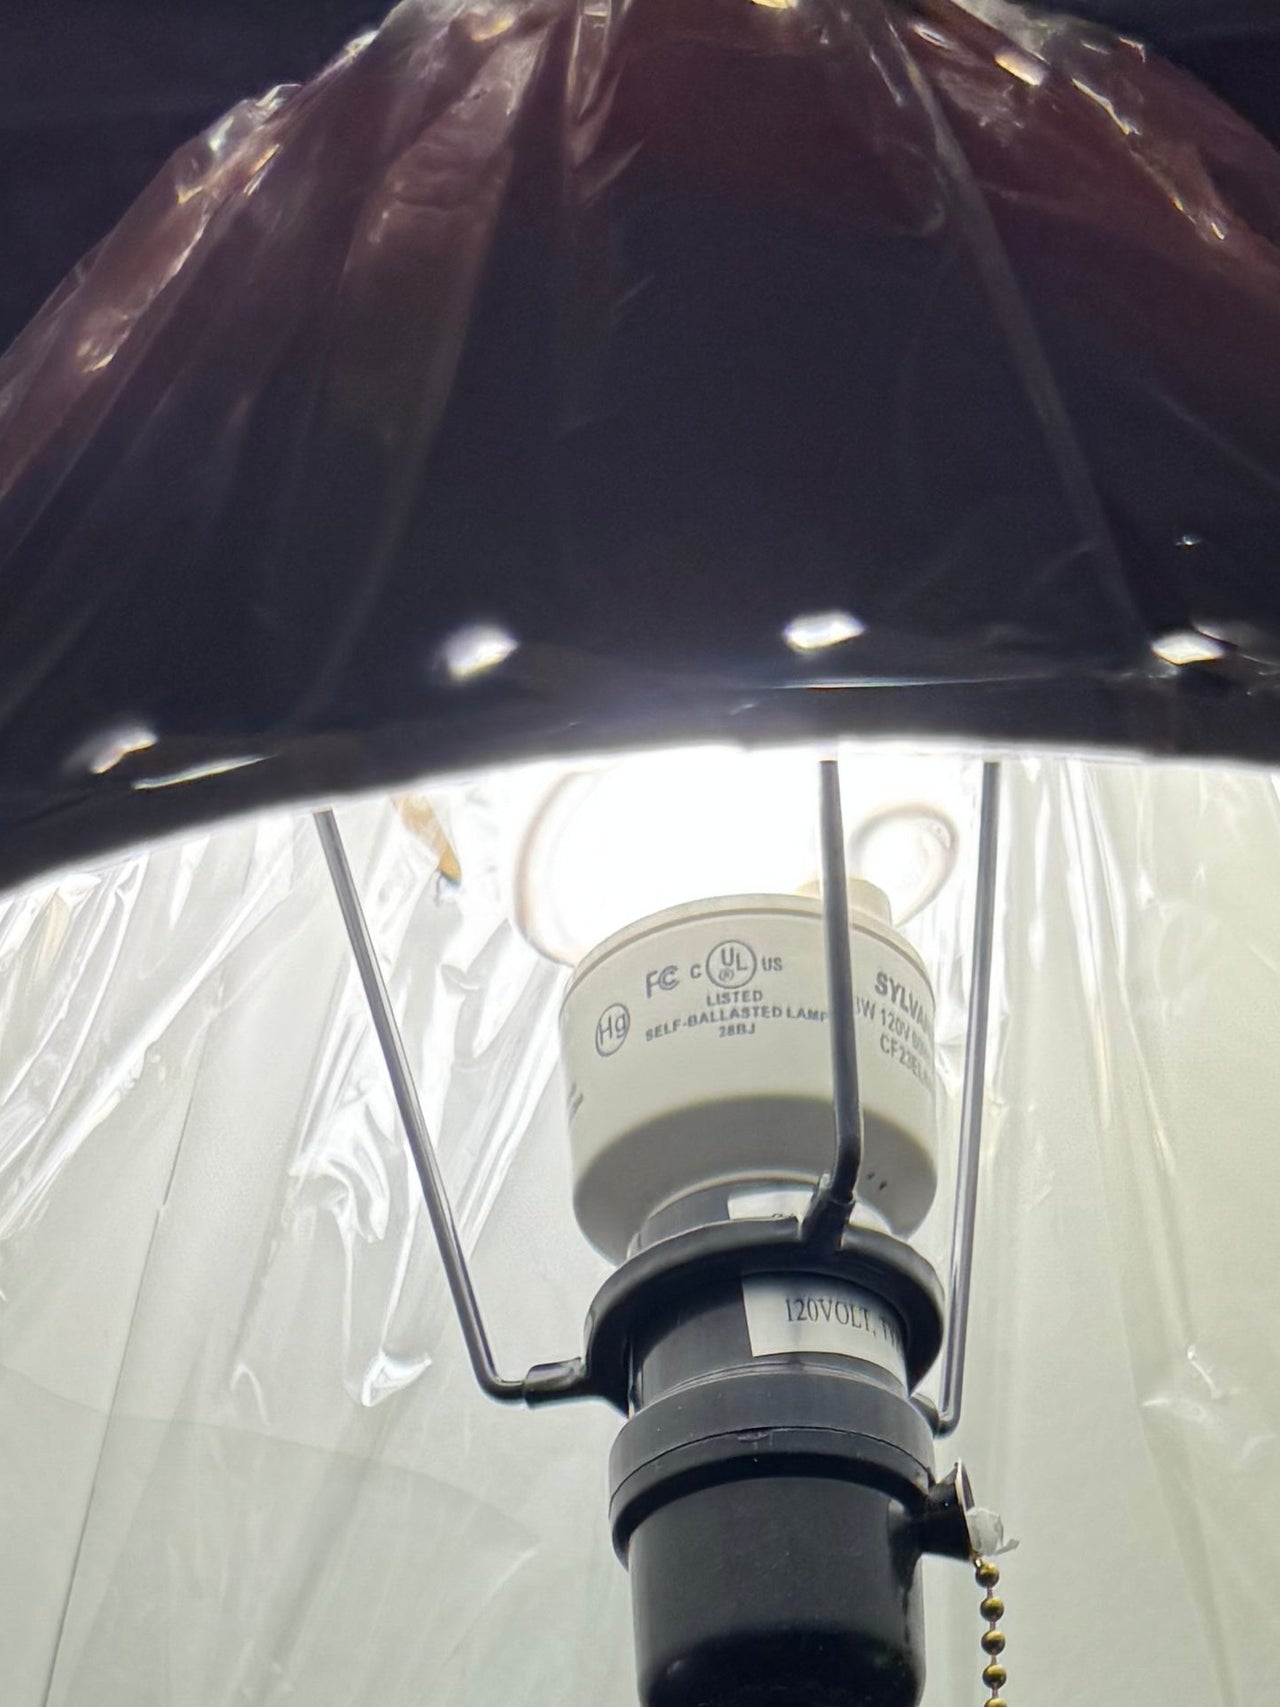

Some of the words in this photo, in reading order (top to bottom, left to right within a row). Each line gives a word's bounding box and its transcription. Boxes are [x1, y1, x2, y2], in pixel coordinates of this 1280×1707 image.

[706, 990, 763, 1007] LISTED
[597, 1012, 626, 1046] Hg
[645, 1005, 783, 1042] SELF-BALLASTED
[880, 1008, 910, 1042] 120V
